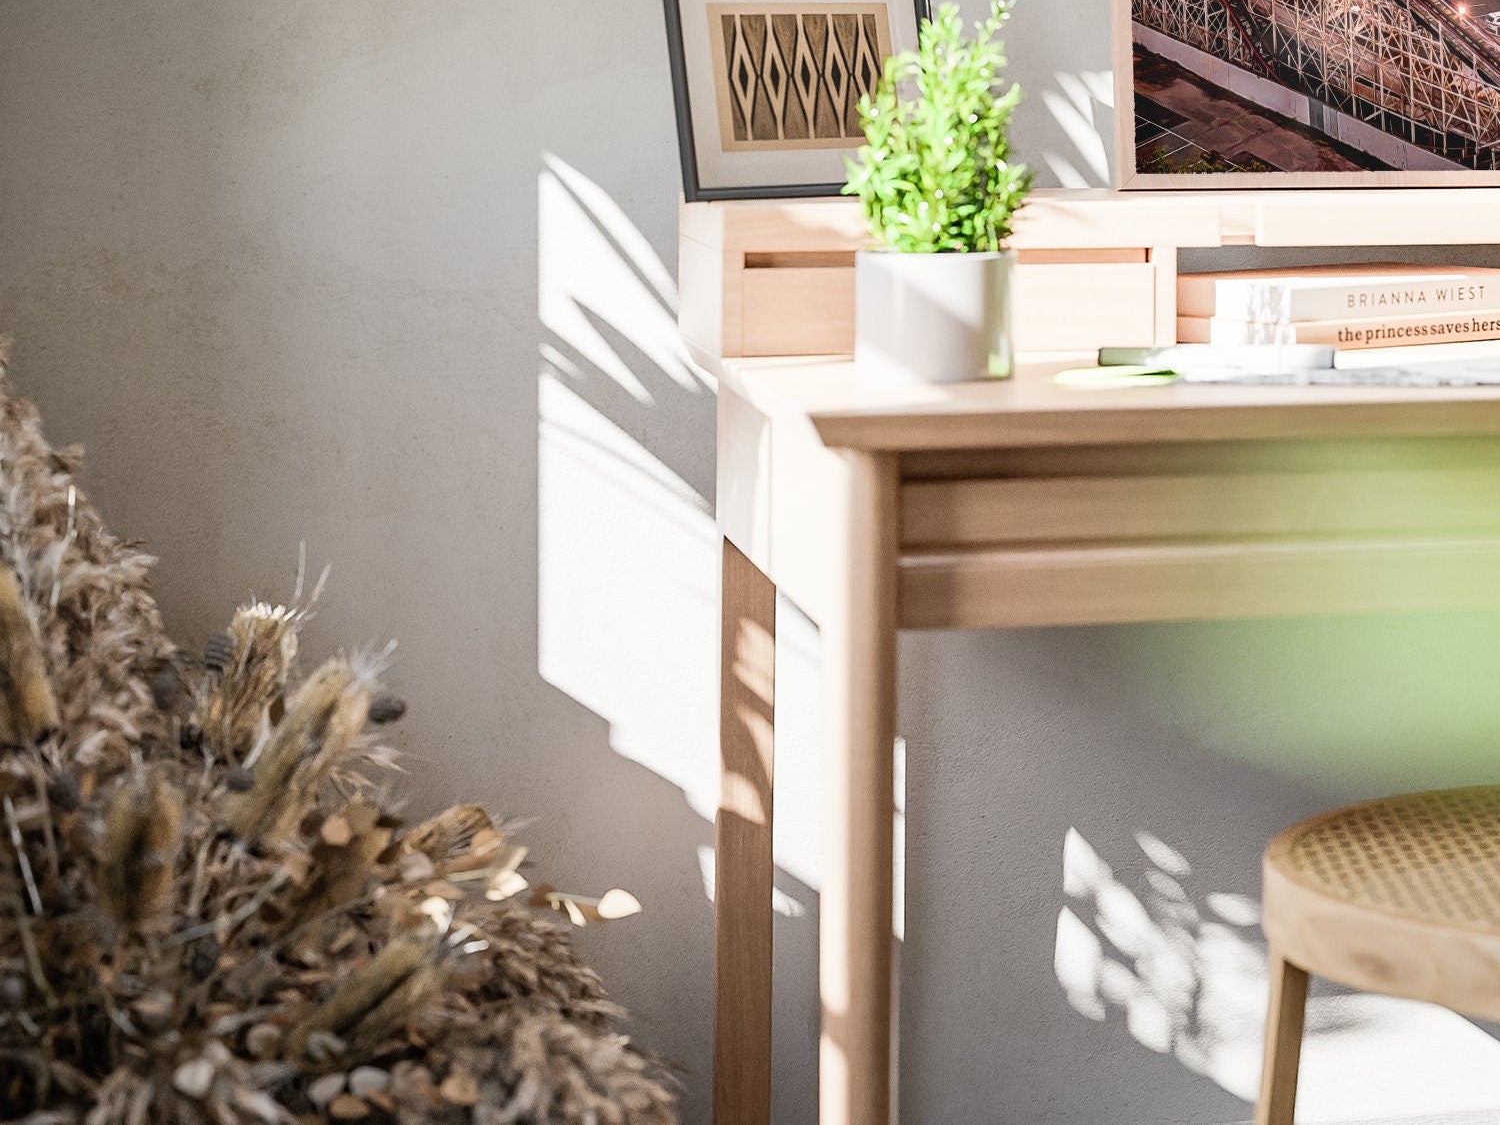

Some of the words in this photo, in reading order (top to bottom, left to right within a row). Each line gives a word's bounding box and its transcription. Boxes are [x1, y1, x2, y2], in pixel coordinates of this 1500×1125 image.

[1347, 291, 1427, 308] BRIANNA
[1435, 285, 1486, 302] WIEST
[1338, 327, 1363, 343] the
[1365, 323, 1428, 345] princess
[1430, 321, 1470, 335] saves
